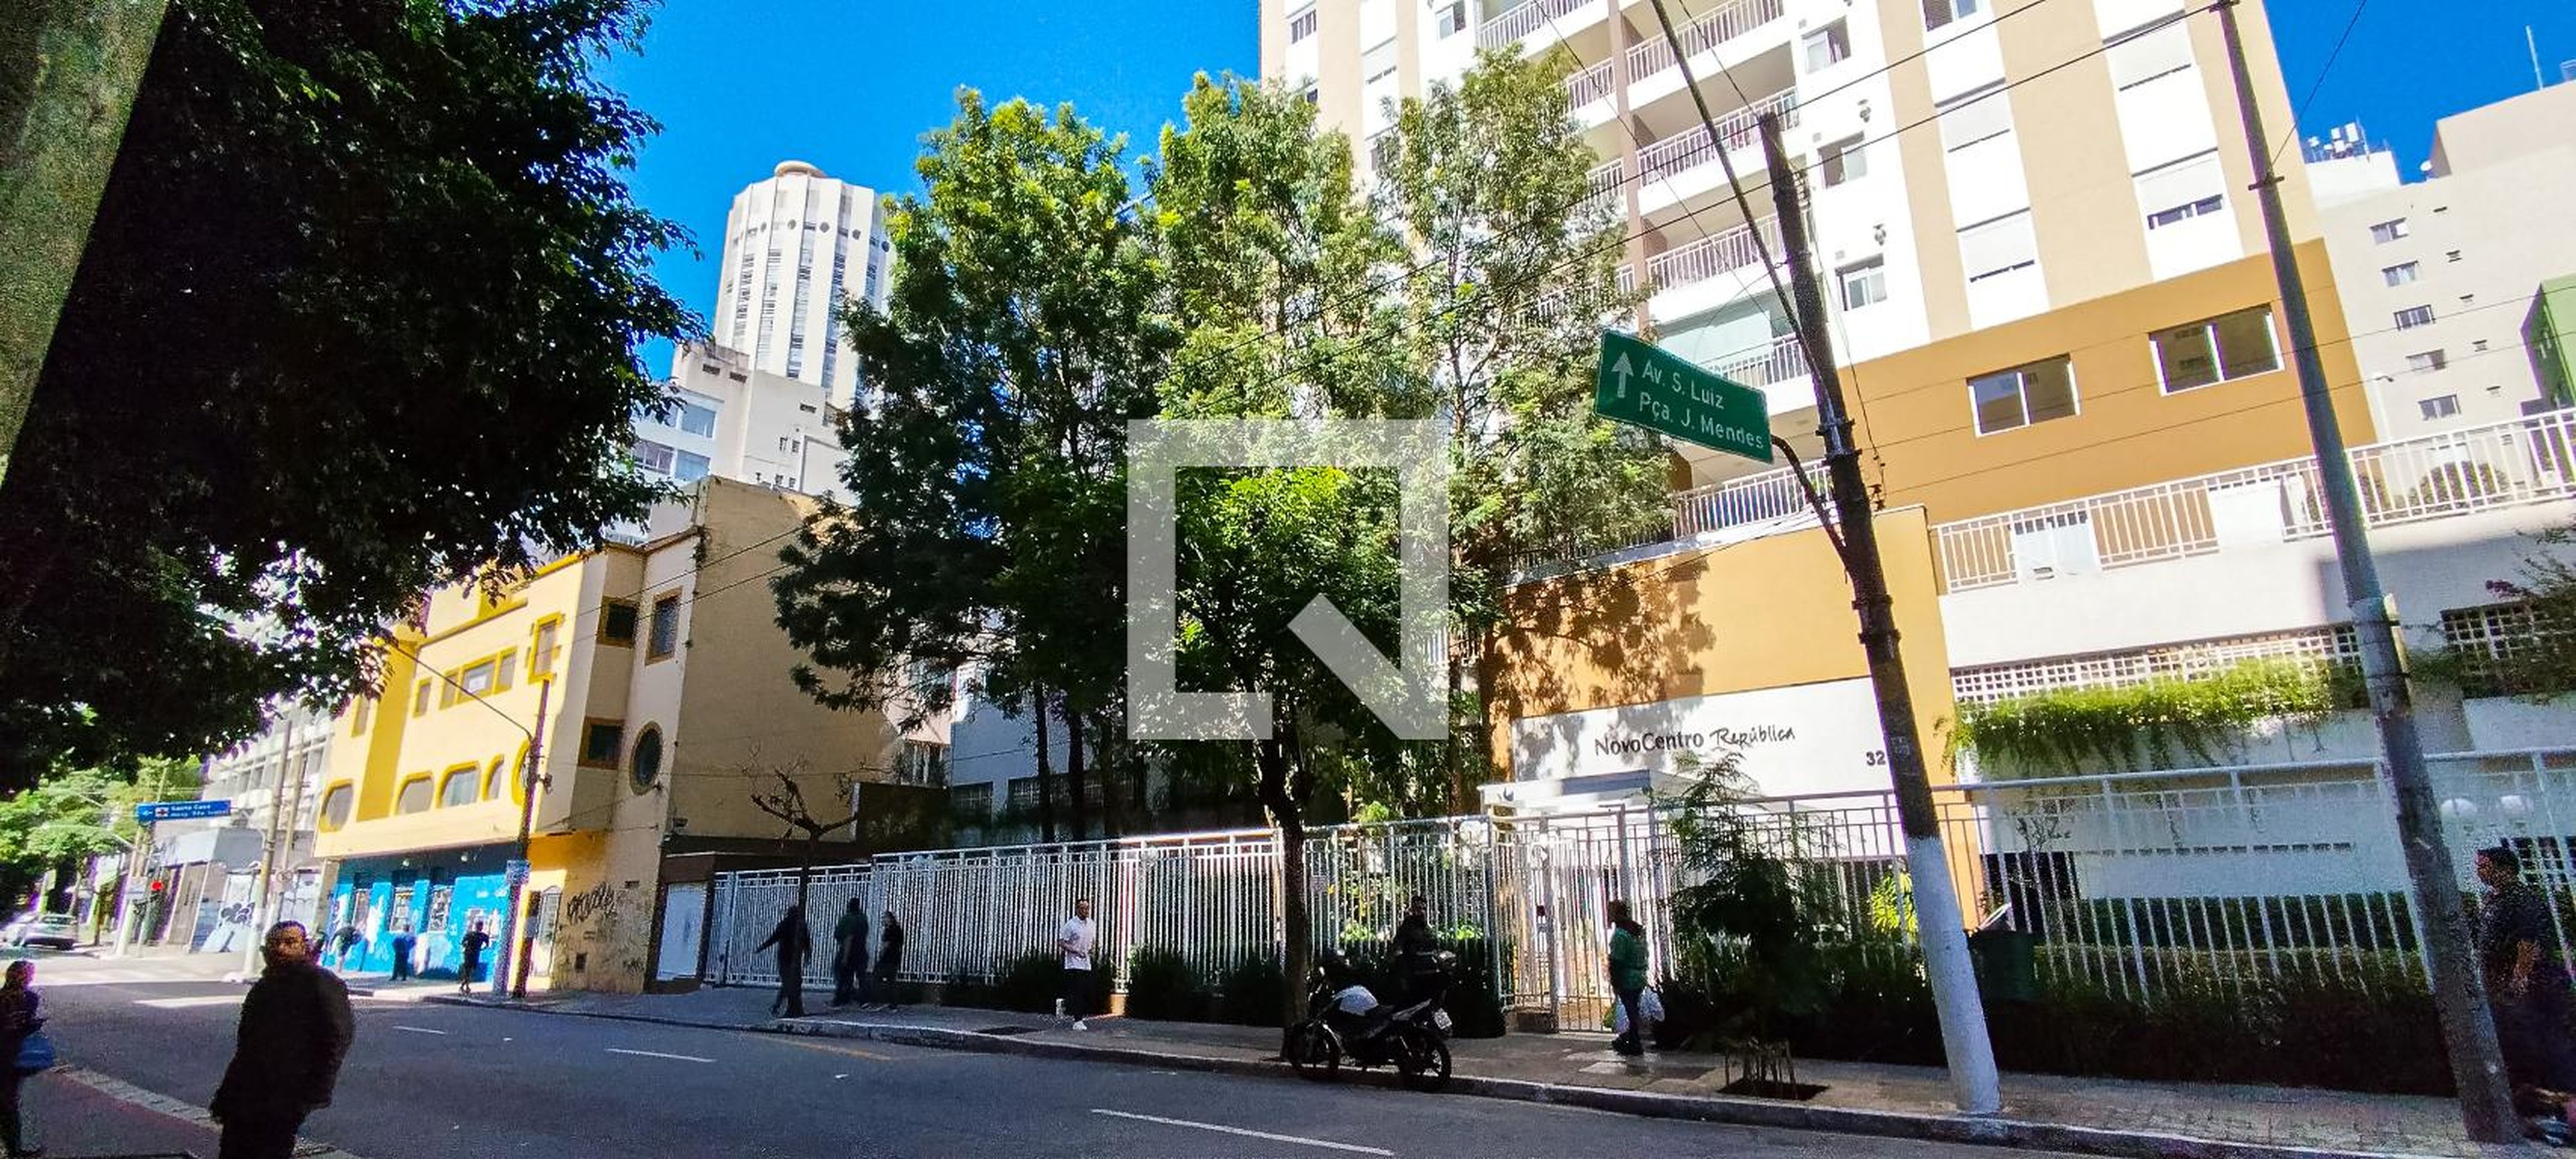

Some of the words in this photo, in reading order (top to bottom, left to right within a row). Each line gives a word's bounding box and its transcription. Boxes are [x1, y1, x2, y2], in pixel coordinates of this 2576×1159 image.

[1642, 360, 1665, 387] Av.
[1672, 372, 1685, 396] S.
[1690, 380, 1724, 410] Luiz
[1640, 392, 1673, 423] Pça.
[1680, 408, 1695, 430] J.
[1700, 415, 1764, 449] Mendes
[1595, 731, 1704, 756] NovoCentro
[1710, 725, 1795, 750] República
